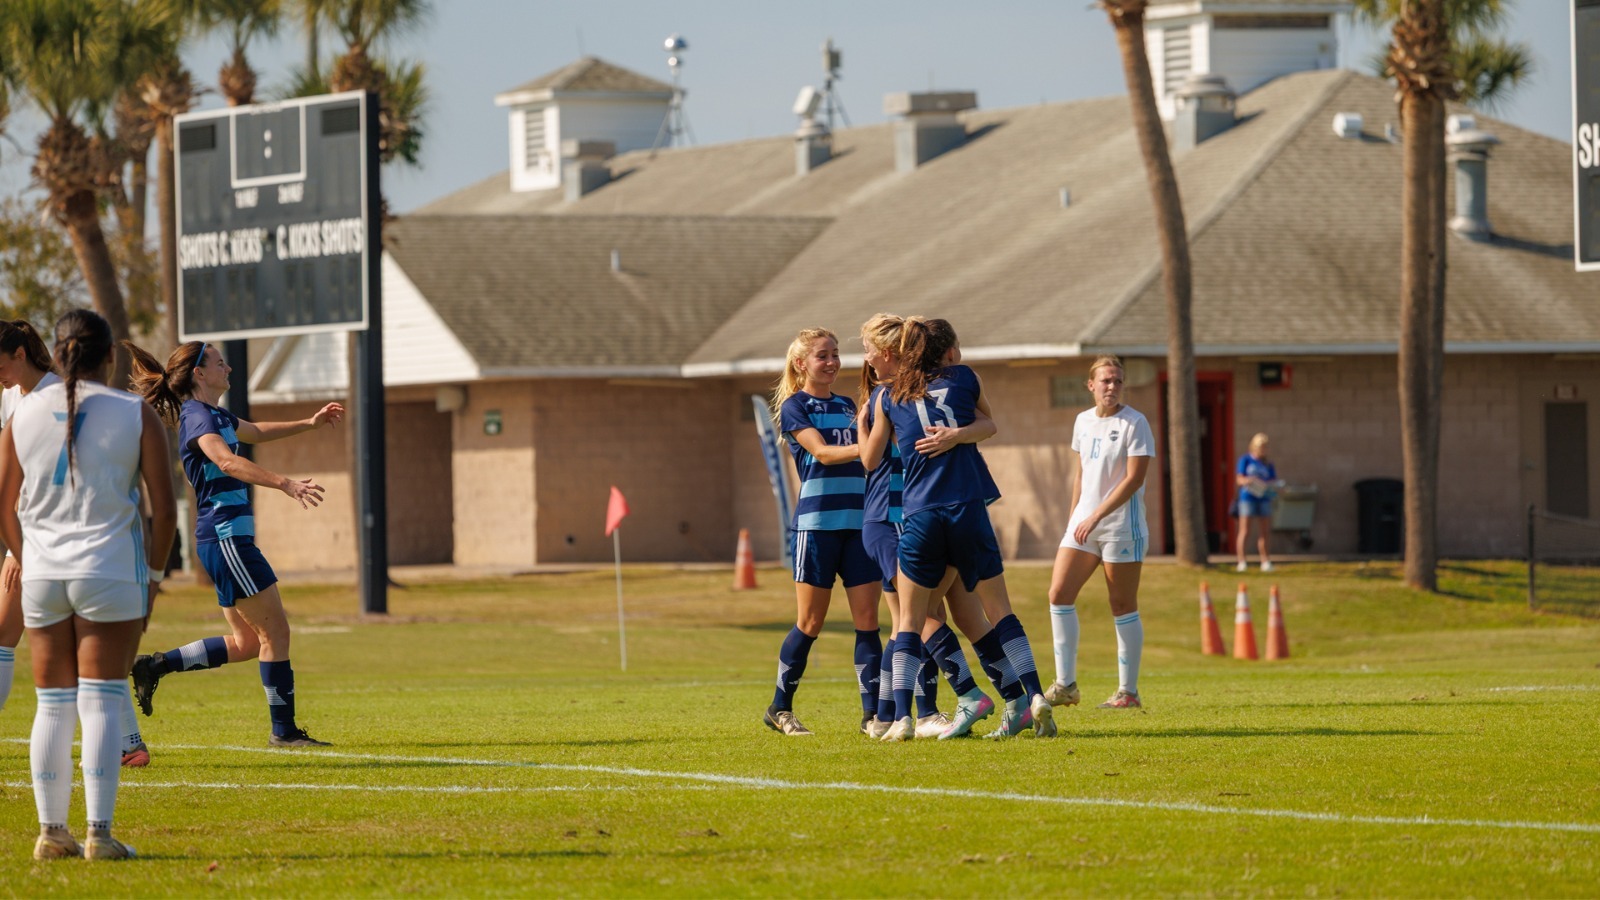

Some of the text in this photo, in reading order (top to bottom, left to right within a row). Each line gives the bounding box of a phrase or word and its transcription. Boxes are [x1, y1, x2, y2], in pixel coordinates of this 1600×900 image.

[180, 231, 218, 270] SHOTS
[230, 227, 263, 264] KICKS
[288, 221, 321, 258] KICKS
[321, 217, 362, 256] SHOTS
[915, 387, 958, 438] 13
[53, 412, 87, 485] 7
[832, 428, 854, 446] 28
[1090, 437, 1103, 459] 13
